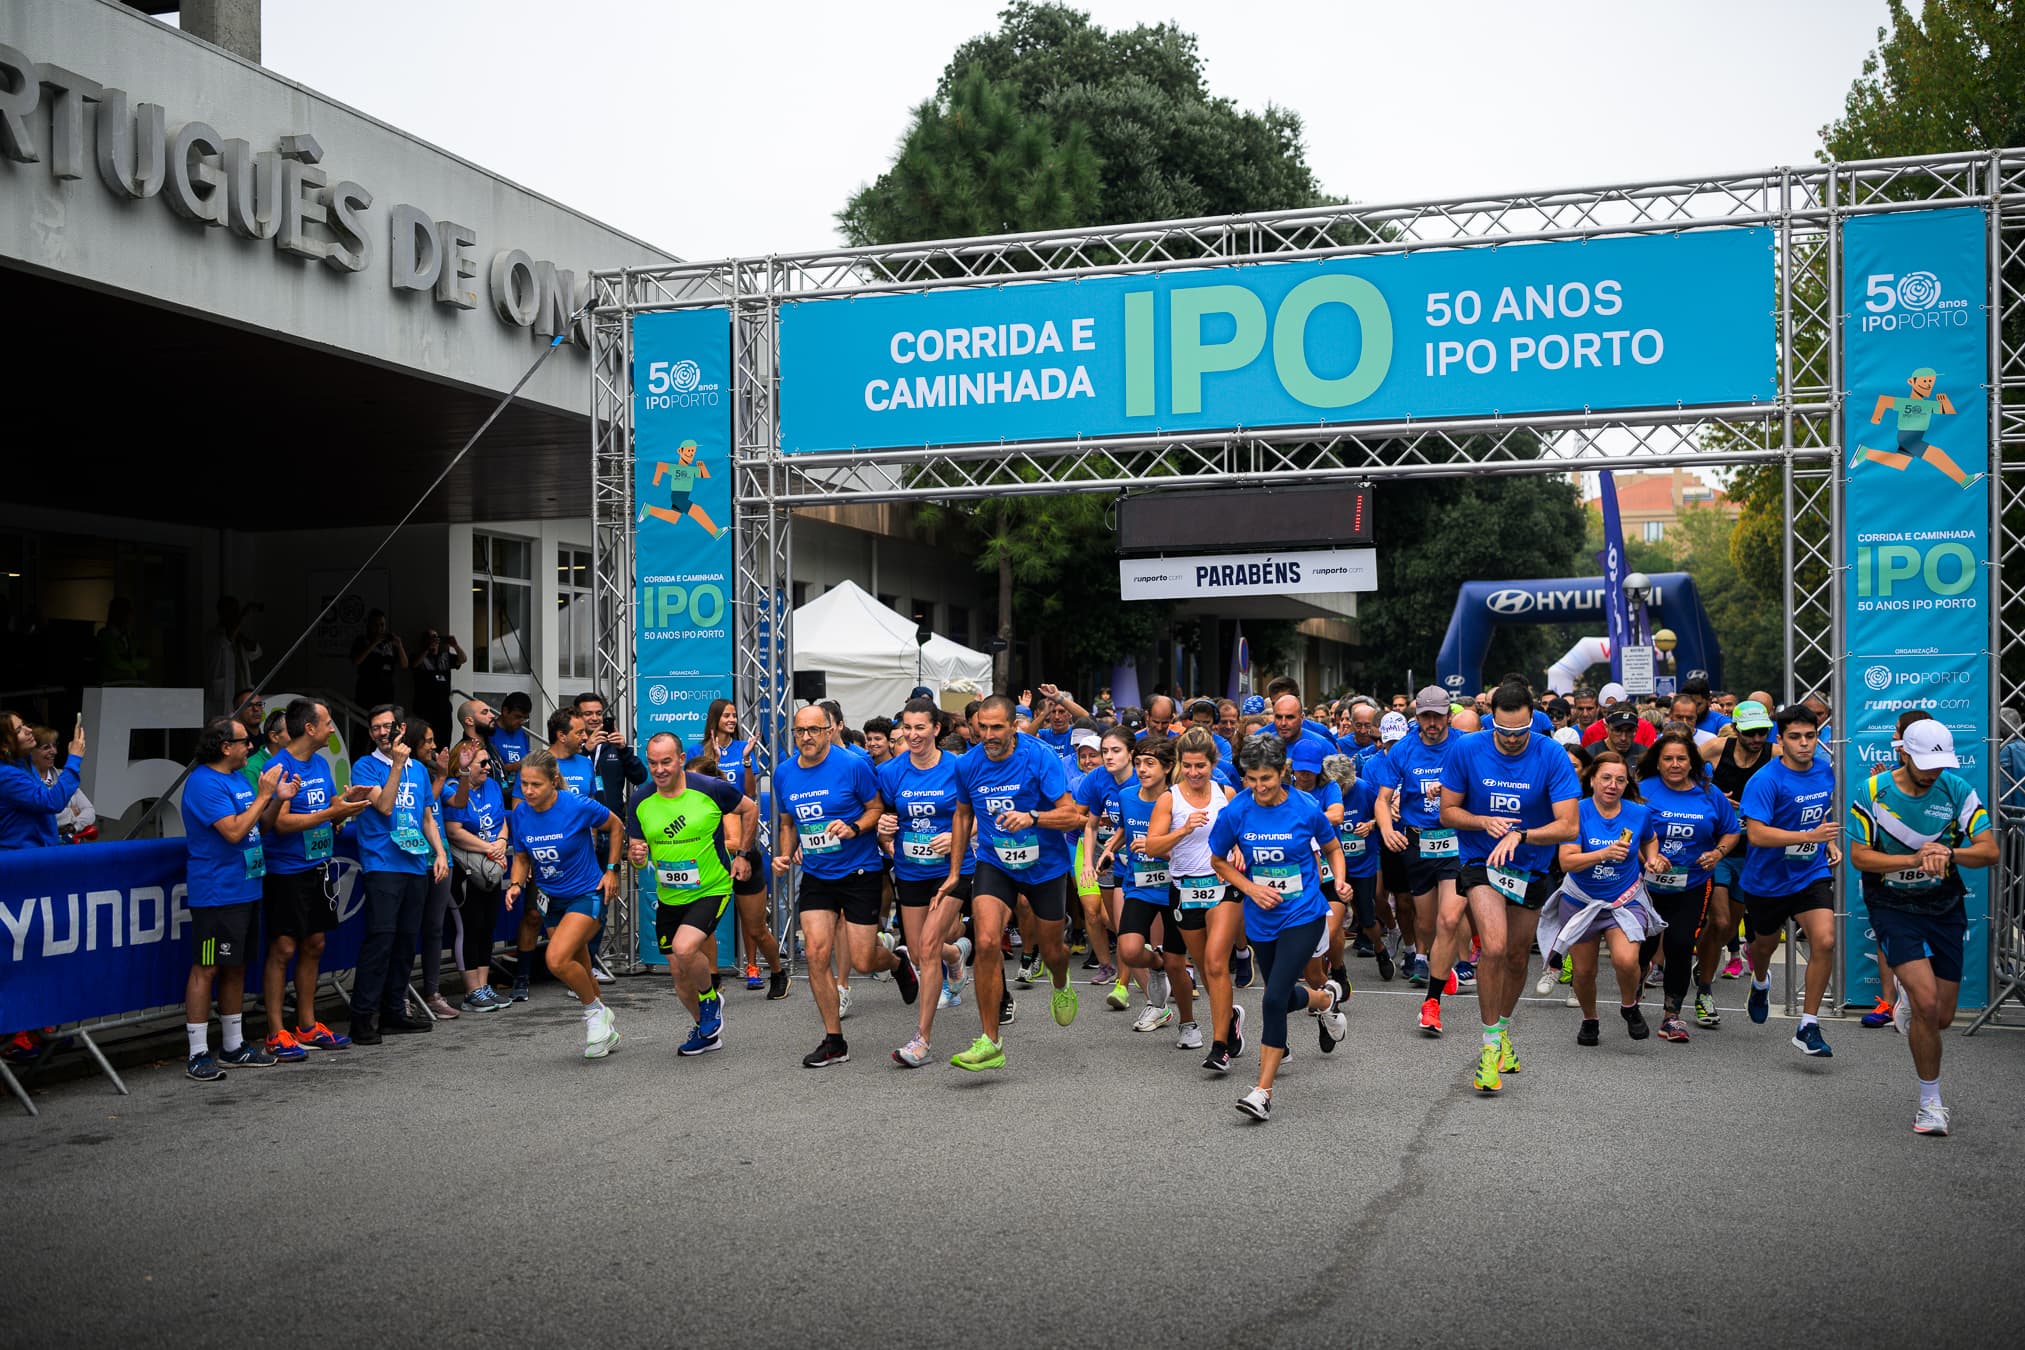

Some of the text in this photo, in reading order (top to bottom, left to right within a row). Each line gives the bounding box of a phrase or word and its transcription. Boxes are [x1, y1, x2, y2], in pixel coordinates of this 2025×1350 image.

[391, 203, 477, 311] DE
[1426, 279, 1623, 327] 50 ANOS
[1938, 299, 1968, 309] anos
[889, 318, 1096, 364] CORRIDA E
[1124, 273, 1394, 417] IPO
[1426, 328, 1664, 377] IPO PORTO
[698, 383, 719, 391] anos
[864, 365, 1096, 412] CAMINHADA
[1857, 530, 1976, 543] CORRIDA E CAMINHADA
[1196, 557, 1302, 588] PARABÉNS
[1857, 542, 1976, 597] IPO
[643, 575, 675, 583] CORRIDA
[682, 573, 724, 582] CAMINHADA
[643, 583, 725, 628] IPO
[1858, 598, 1976, 611] 50 ANOS IPO PORTO
[644, 629, 724, 640] 50 ANOS IPO PORTO
[1894, 647, 1939, 655] ORGANIZAÇÃO
[1497, 781, 1531, 790] HYUNDAI
[307, 791, 325, 805] IPO
[1490, 795, 1520, 811] IPO
[796, 806, 823, 819] IPO
[908, 804, 936, 817] IPO
[1801, 807, 1823, 822] IPO
[663, 815, 686, 838] SMP
[1667, 824, 1694, 837] IPO
[809, 835, 827, 847] 101
[1343, 842, 1357, 850] 60
[1429, 840, 1450, 850] 376
[912, 846, 933, 856] 525
[1005, 850, 1027, 861] 214
[1253, 849, 1284, 863] IPO
[666, 872, 688, 882] 980
[1146, 872, 1165, 883] 216
[1655, 875, 1677, 885] 165
[1267, 880, 1288, 891] 44
[1192, 889, 1215, 899] 382
